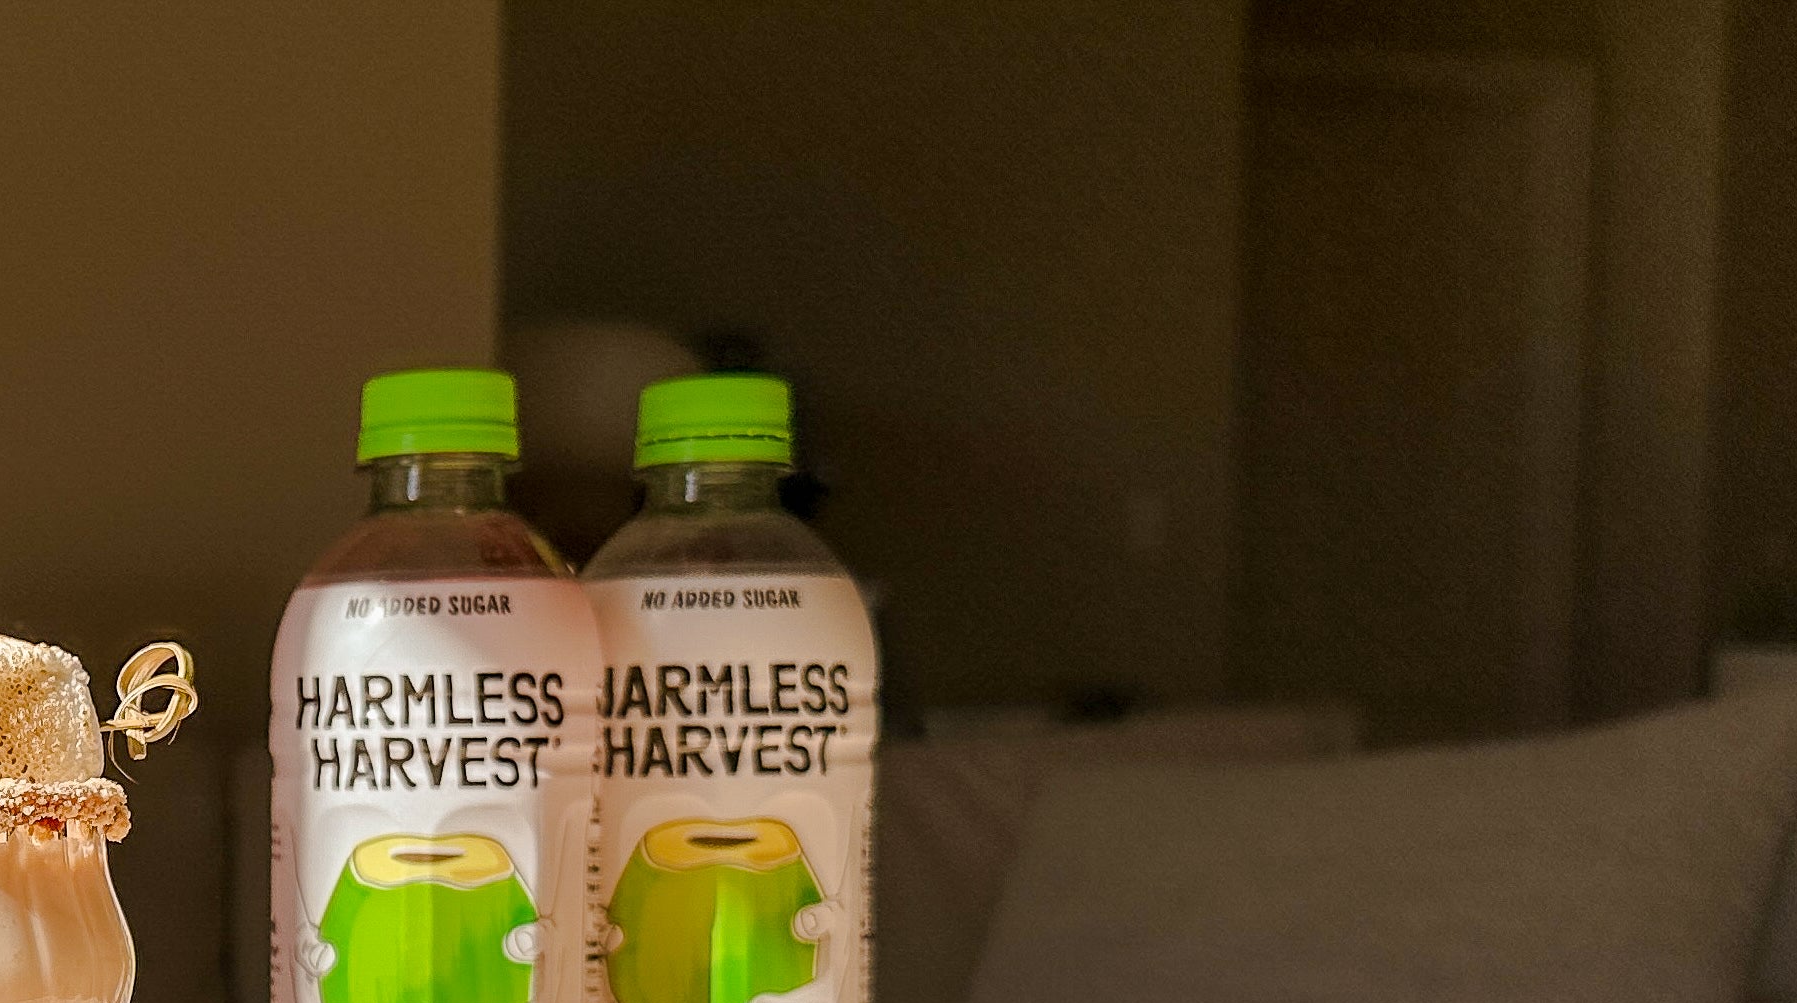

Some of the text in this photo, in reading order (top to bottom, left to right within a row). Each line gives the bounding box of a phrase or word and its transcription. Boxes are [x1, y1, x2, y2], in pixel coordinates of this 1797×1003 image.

[345, 597, 370, 619] NO
[448, 594, 511, 616] SUGAR
[641, 589, 803, 609] NO ADDED SUGAR
[296, 672, 565, 730] HARMLESS
[311, 737, 549, 791] HARVEST
[604, 724, 837, 777] HARVEST
